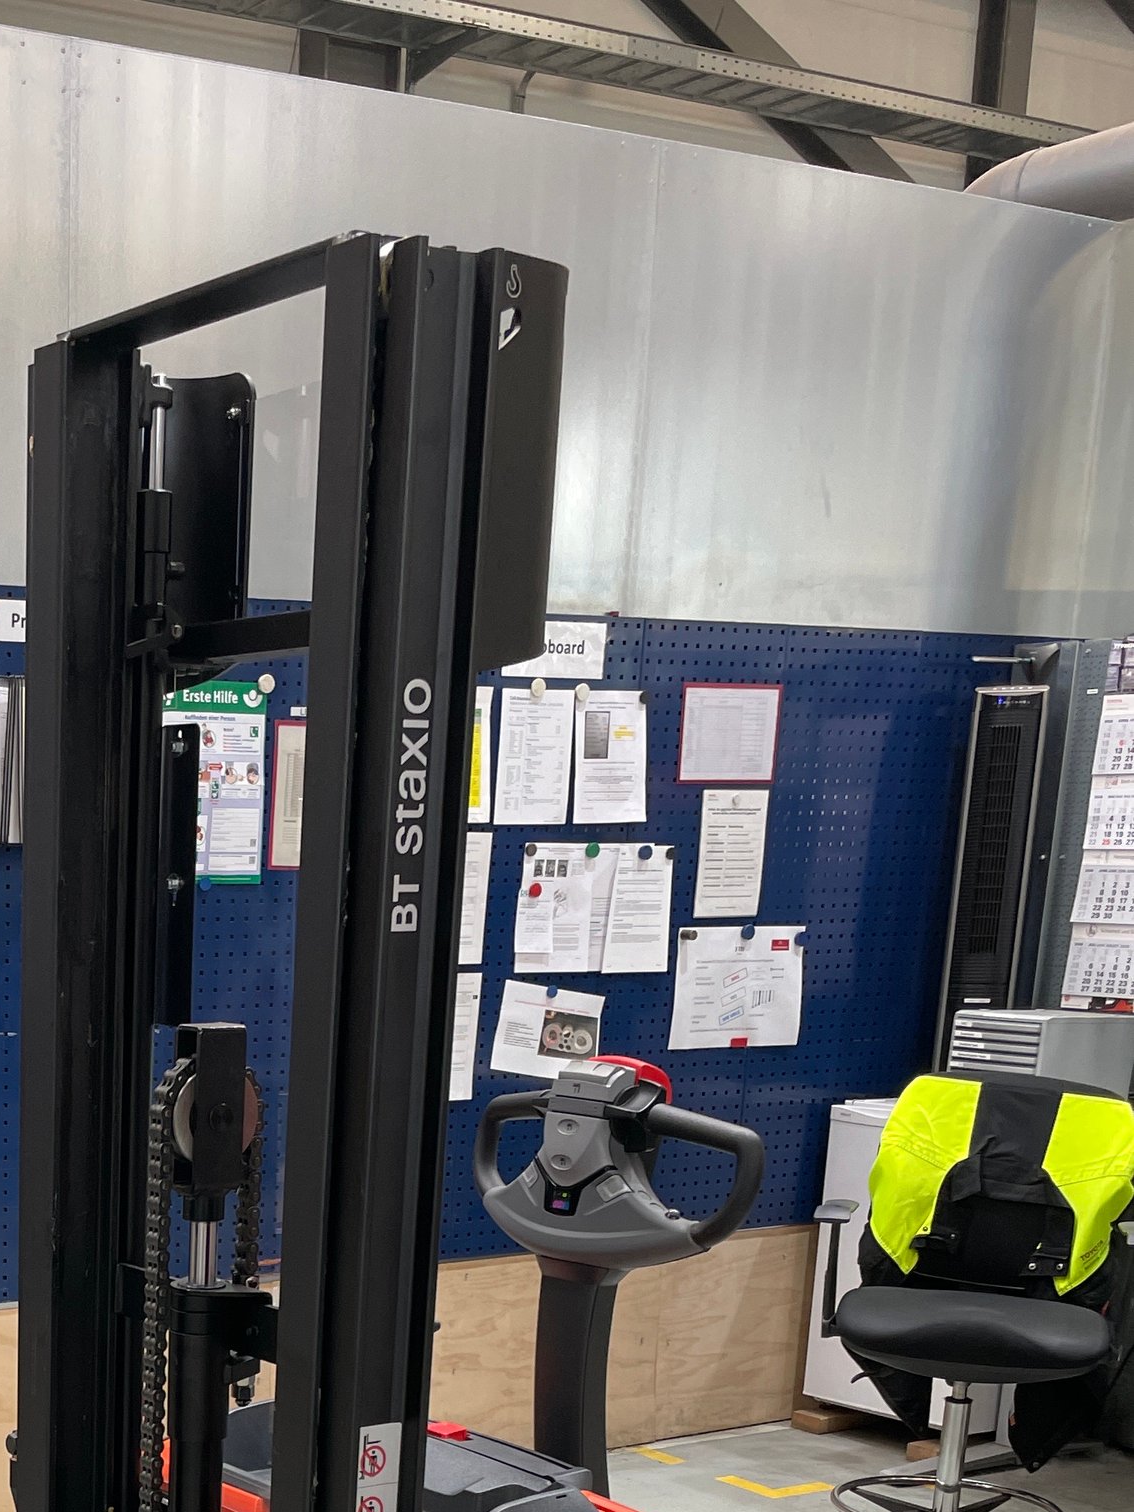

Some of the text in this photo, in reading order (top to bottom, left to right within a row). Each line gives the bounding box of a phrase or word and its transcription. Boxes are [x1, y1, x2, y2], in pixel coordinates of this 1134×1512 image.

[544, 639, 585, 655] board
[182, 689, 239, 704] Erste Hilfe
[390, 678, 432, 932] BT staxio
